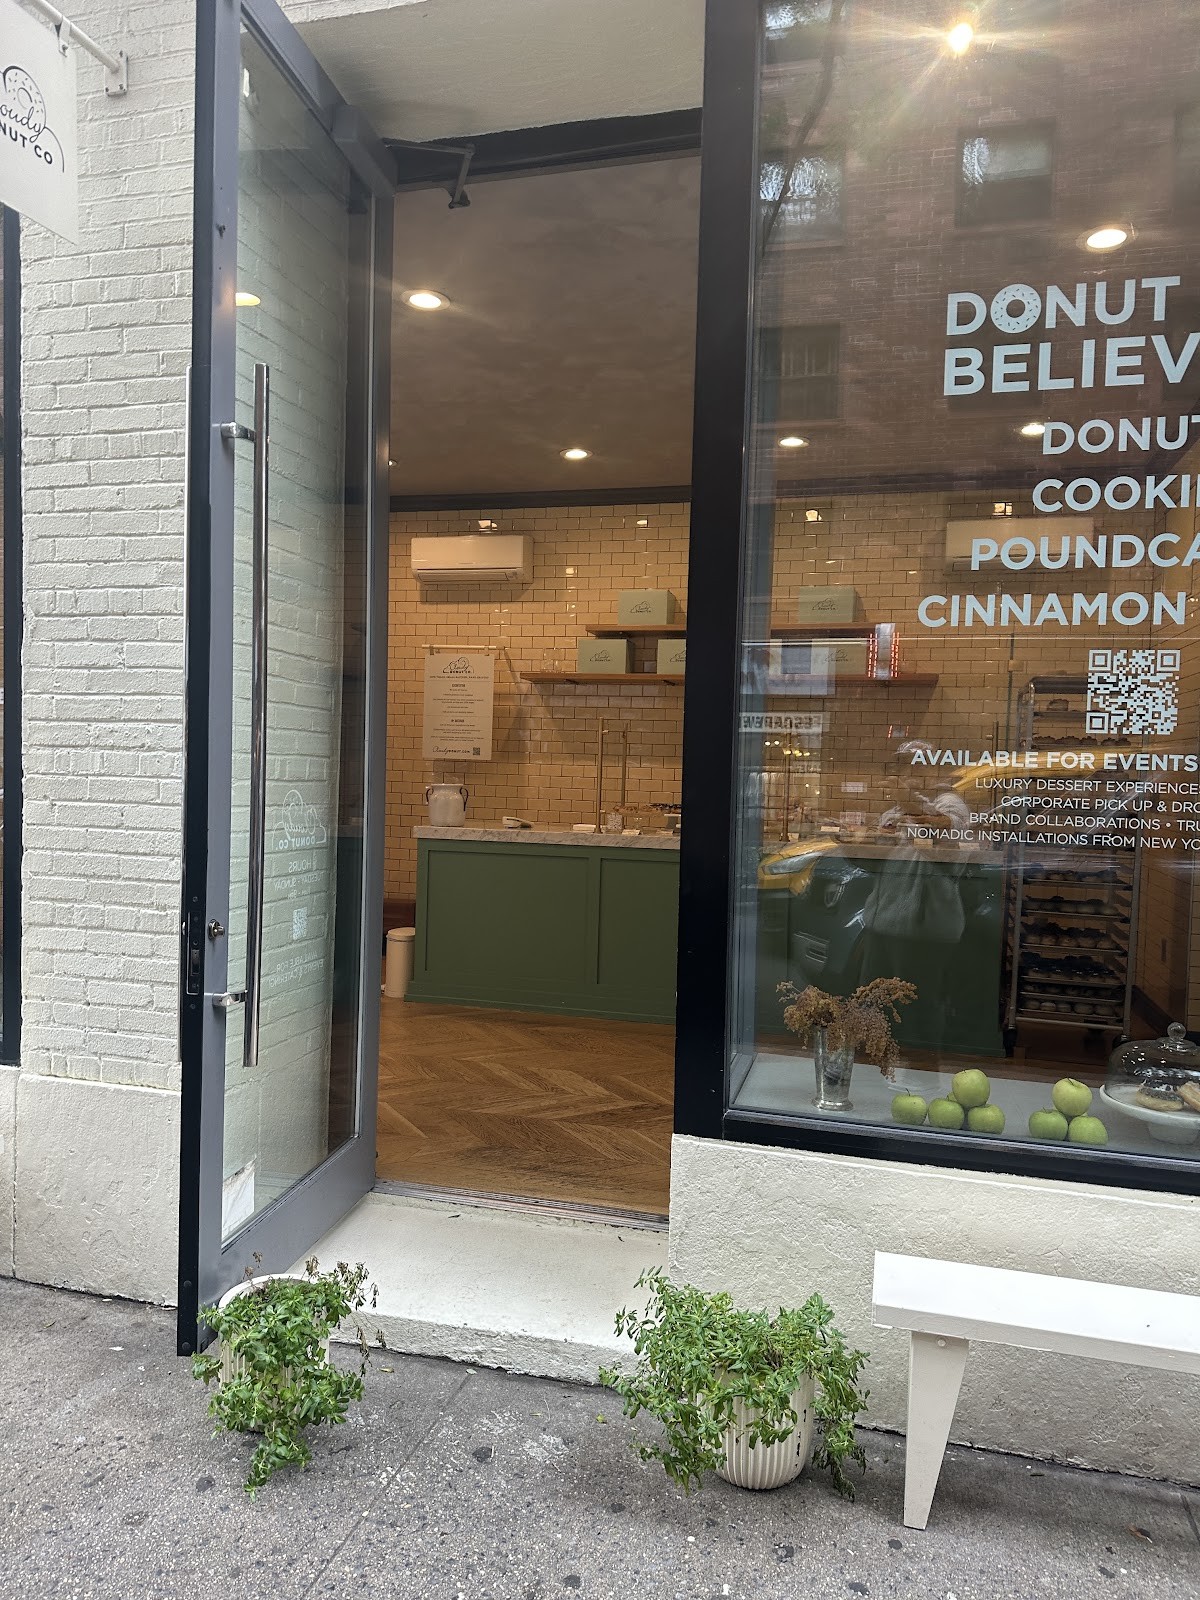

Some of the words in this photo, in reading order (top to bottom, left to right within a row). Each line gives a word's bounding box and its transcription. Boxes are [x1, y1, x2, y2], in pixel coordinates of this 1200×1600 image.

[34, 144, 53, 164] CO
[946, 275, 1181, 335] DONUT
[943, 332, 1200, 396] BELIEV
[1042, 414, 1200, 455] DONU
[1032, 474, 1200, 512] COOKI
[917, 591, 1186, 627] CINNAMON
[911, 749, 1039, 768] AVAILABLE
[1046, 751, 1095, 770] FOR
[1103, 753, 1199, 772] EVENTS
[975, 778, 1032, 790] LUXURY
[1036, 779, 1101, 792] DESSERT
[1106, 781, 1200, 795] EXPERIENCE
[1001, 796, 1090, 810] CORPORATE
[1095, 799, 1128, 811] PICK
[1132, 800, 1153, 812] UP
[1156, 801, 1167, 812] &
[969, 812, 1021, 825] BRAND
[1025, 814, 1160, 830] COLLABORATIONS
[907, 827, 974, 841] NOMADIC
[978, 830, 1088, 846] INSTALLATIONS
[1092, 835, 1135, 848] FROM
[1140, 836, 1177, 849] NEW
